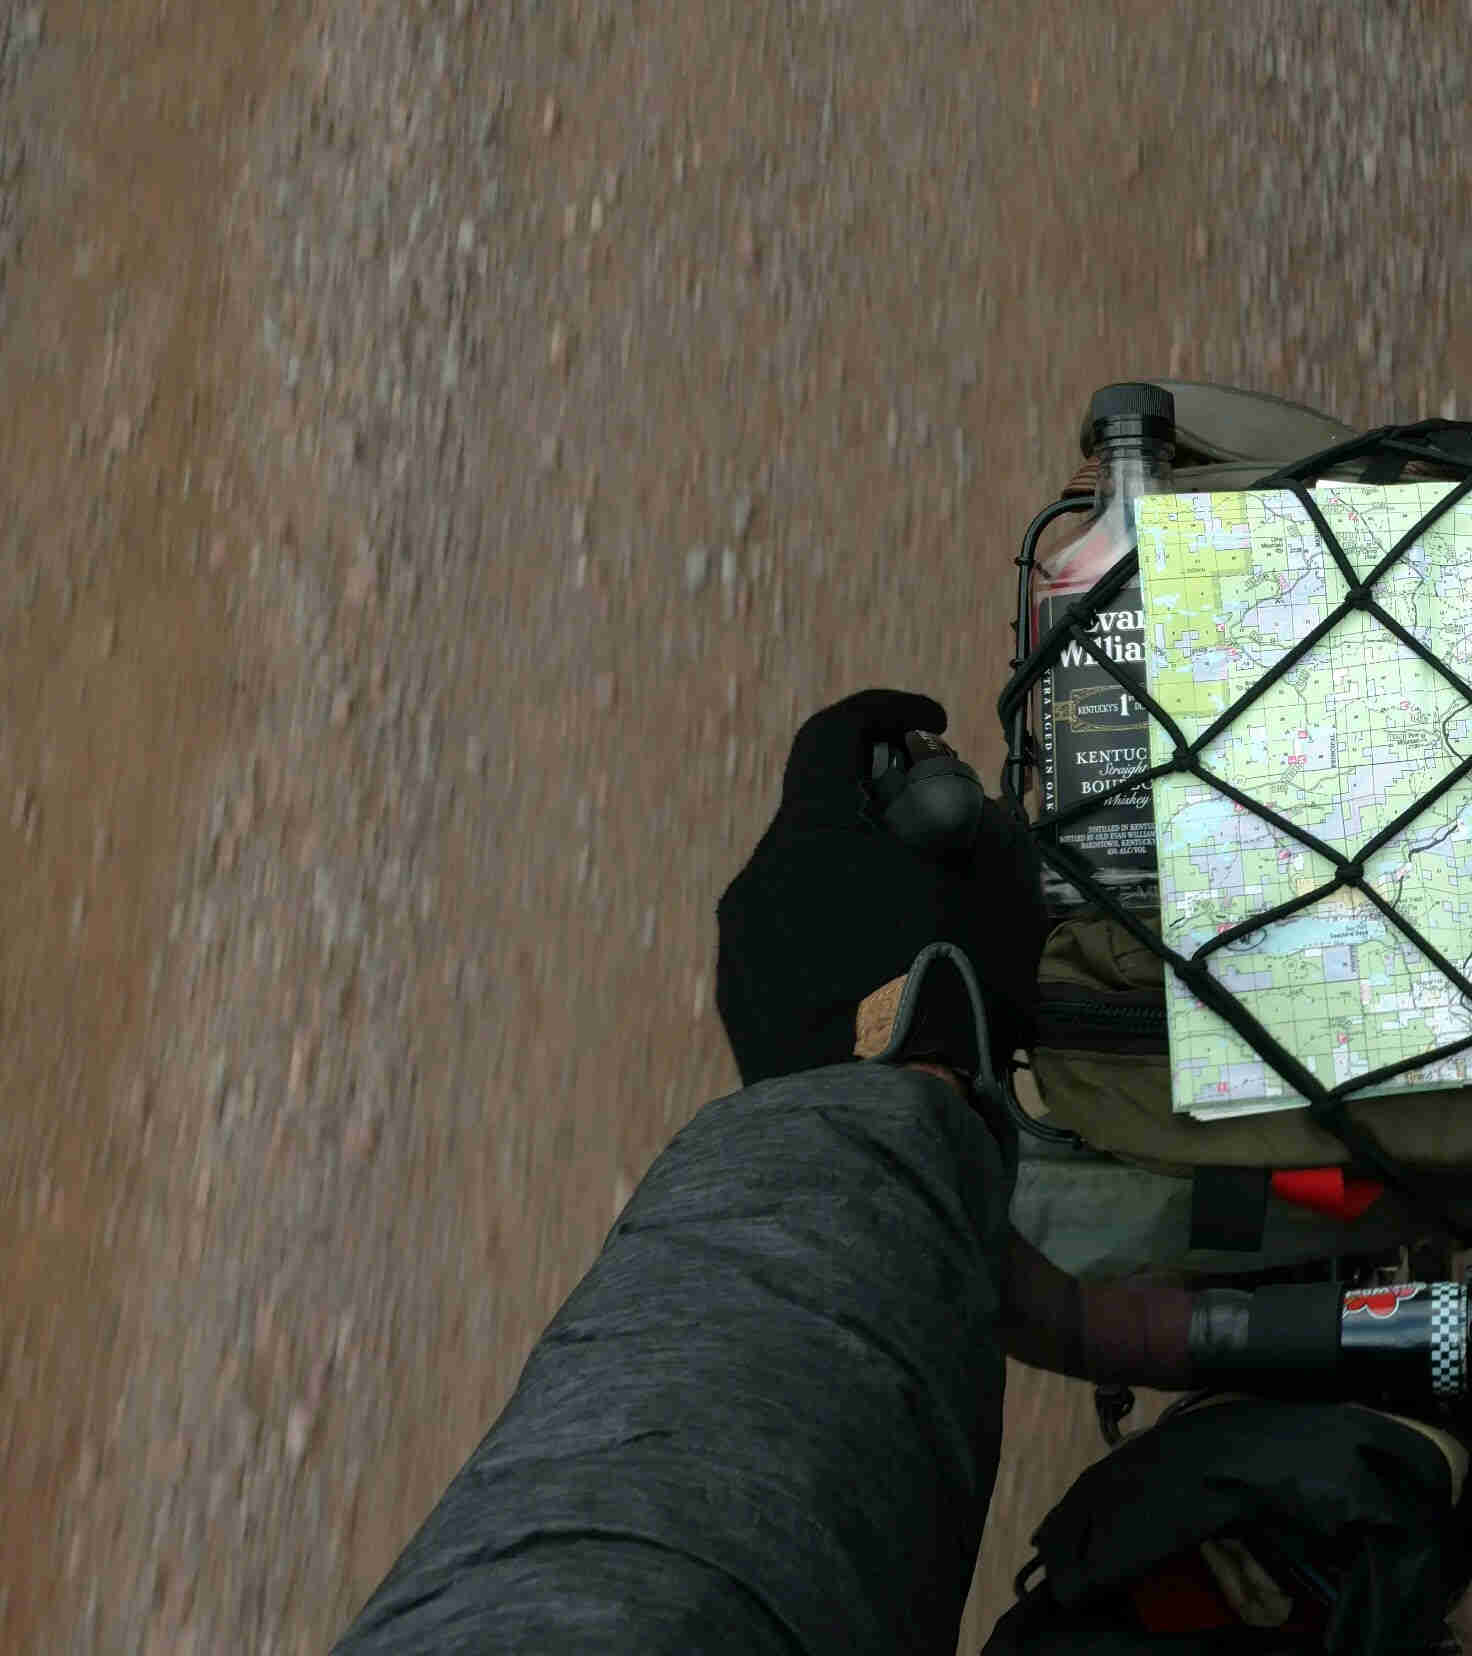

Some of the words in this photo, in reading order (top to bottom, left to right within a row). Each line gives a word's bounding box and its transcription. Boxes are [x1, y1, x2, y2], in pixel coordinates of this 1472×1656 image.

[1084, 610, 1145, 633] va
[1044, 712, 1053, 750] AGED
[1045, 758, 1054, 775] IN
[1046, 781, 1055, 811] OAK
